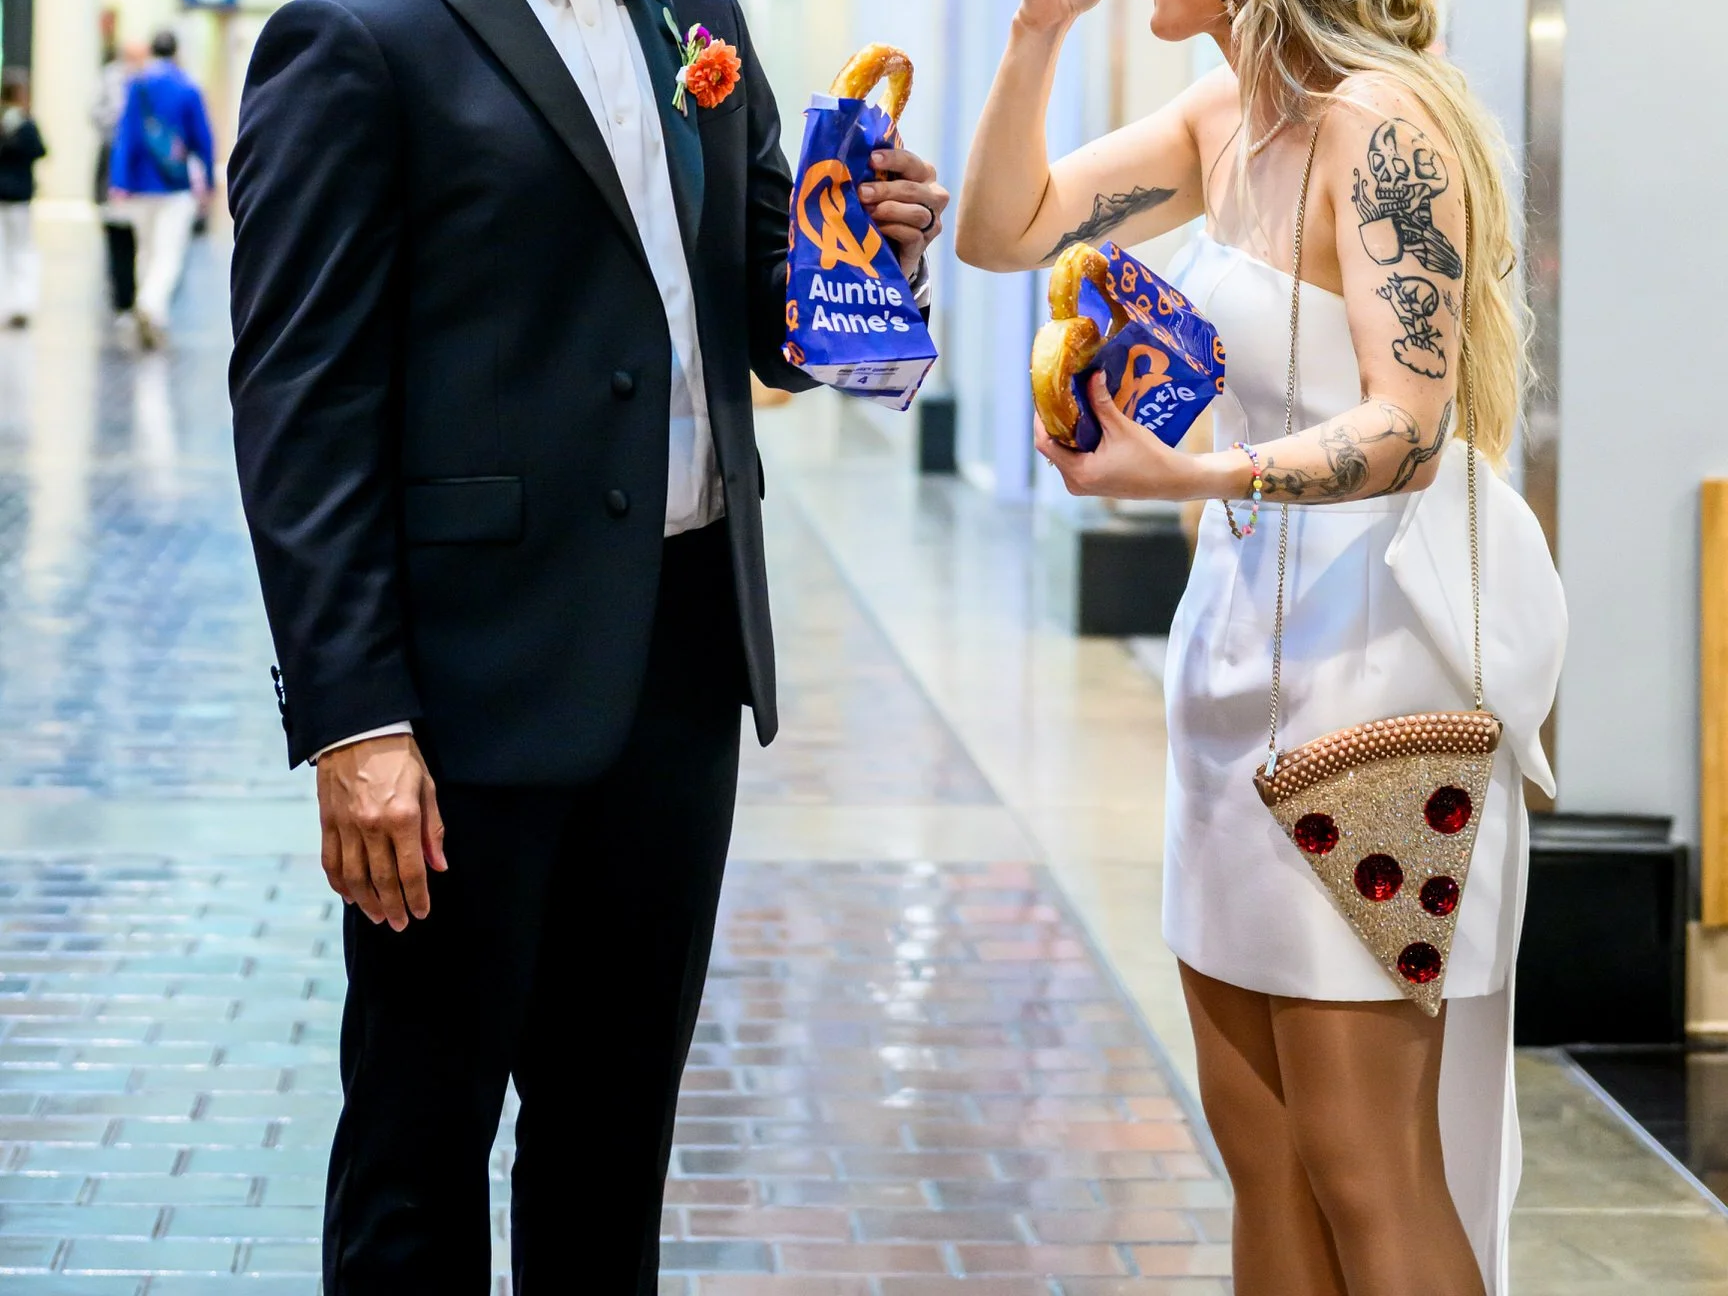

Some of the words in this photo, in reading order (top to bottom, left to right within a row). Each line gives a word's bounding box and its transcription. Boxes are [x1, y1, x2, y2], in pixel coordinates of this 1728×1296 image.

[809, 273, 903, 306] Auntie
[812, 305, 910, 333] Anne's
[1136, 383, 1196, 424] ntie
